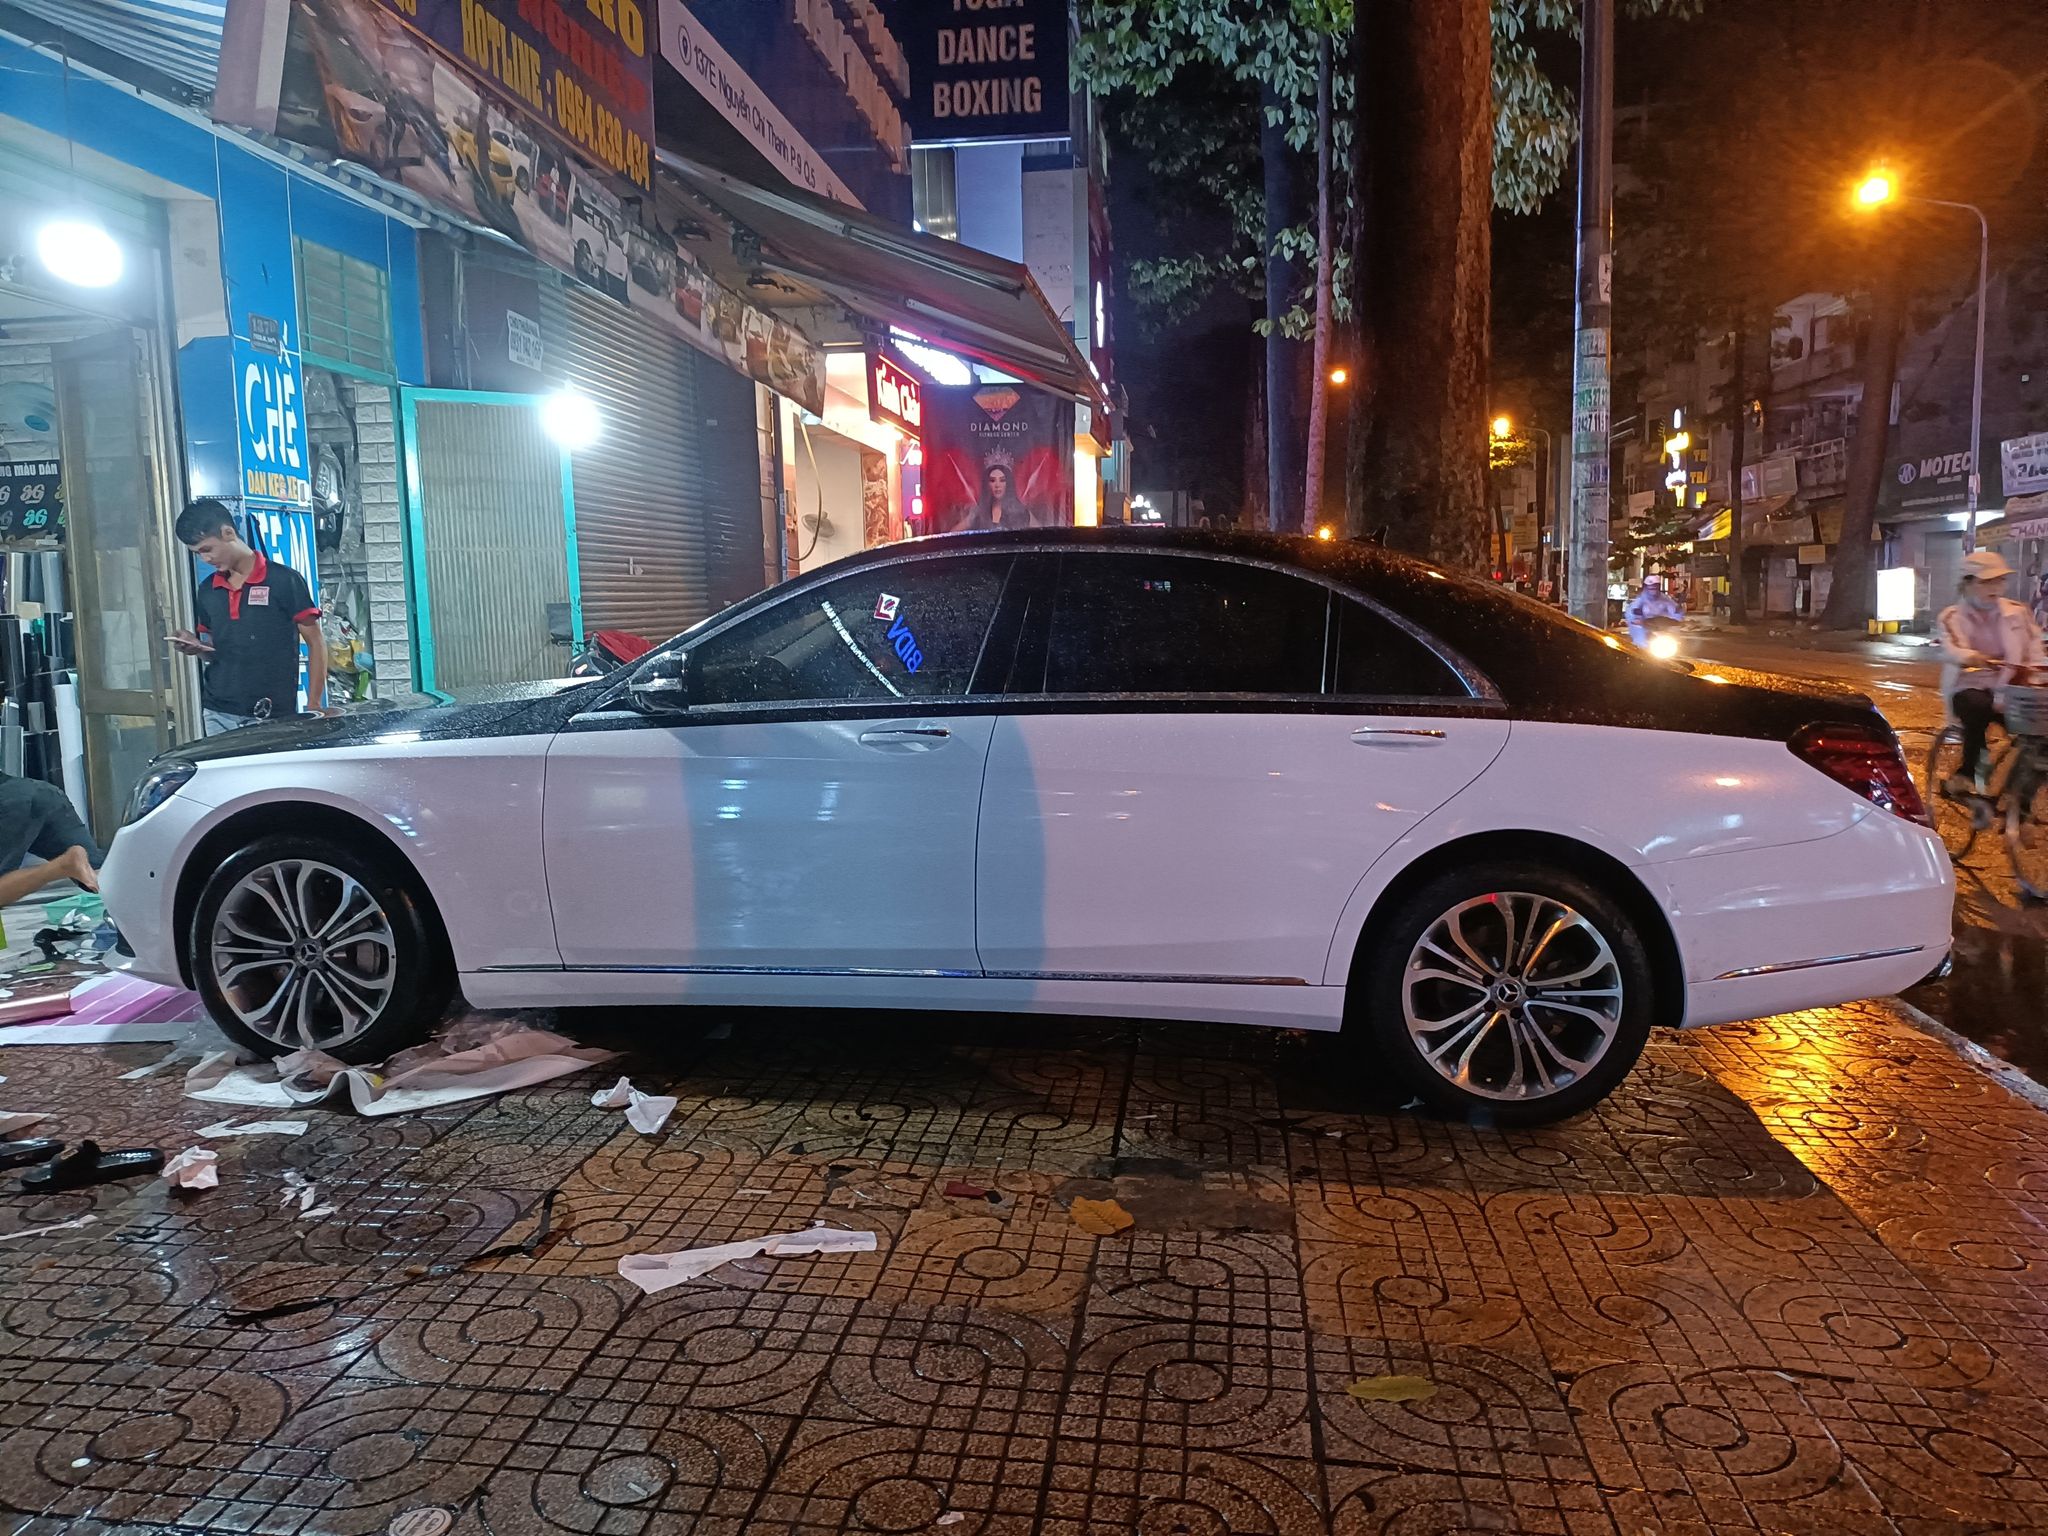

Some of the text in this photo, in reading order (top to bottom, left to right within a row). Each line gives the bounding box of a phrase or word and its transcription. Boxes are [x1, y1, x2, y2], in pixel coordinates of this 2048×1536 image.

[938, 23, 1036, 66] DANCE
[694, 45, 717, 89] 137E
[460, 0, 543, 112] HOTLINE
[554, 69, 650, 192] 0964.839.434
[933, 76, 1043, 119] BOXING
[244, 320, 300, 468] CHẾ
[970, 422, 1029, 433] DIAMOND
[14, 462, 36, 477] MÀU
[38, 461, 58, 475] DÁN
[247, 465, 267, 496] DÁN
